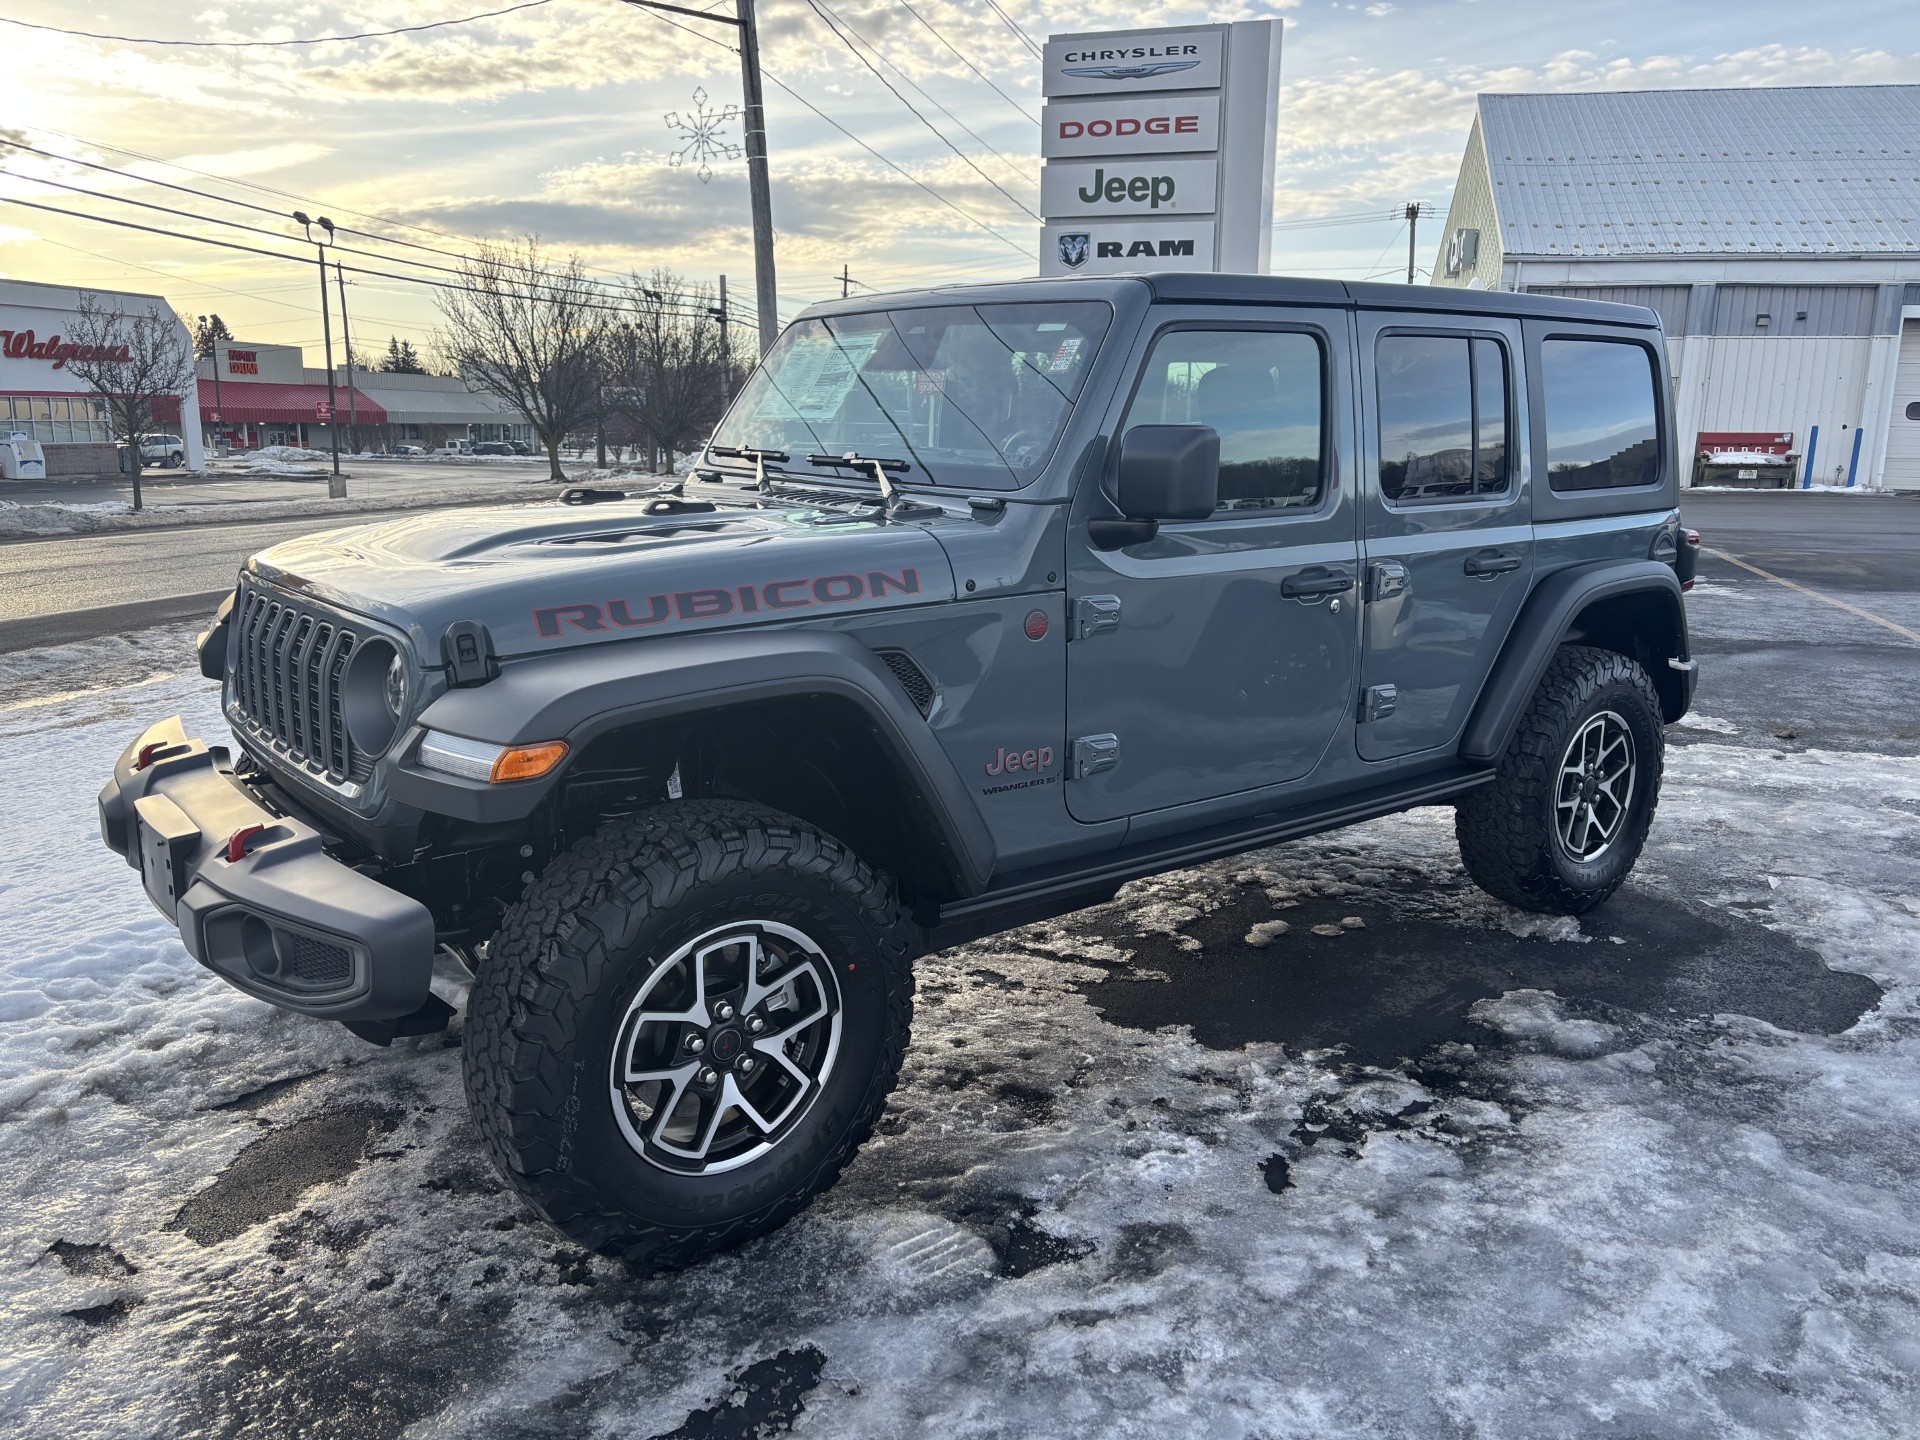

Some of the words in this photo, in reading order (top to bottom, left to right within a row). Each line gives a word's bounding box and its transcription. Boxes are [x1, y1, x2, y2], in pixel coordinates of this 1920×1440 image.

[1064, 45, 1198, 62] CHRYSLER
[1059, 116, 1199, 139] DODGE
[1078, 168, 1175, 208] Jeep
[1097, 240, 1194, 258] RAM
[0, 329, 134, 369] Walgreens
[532, 568, 921, 639] RUBICON
[985, 746, 1054, 776] Jeep
[982, 778, 1044, 796] WRANGLER
